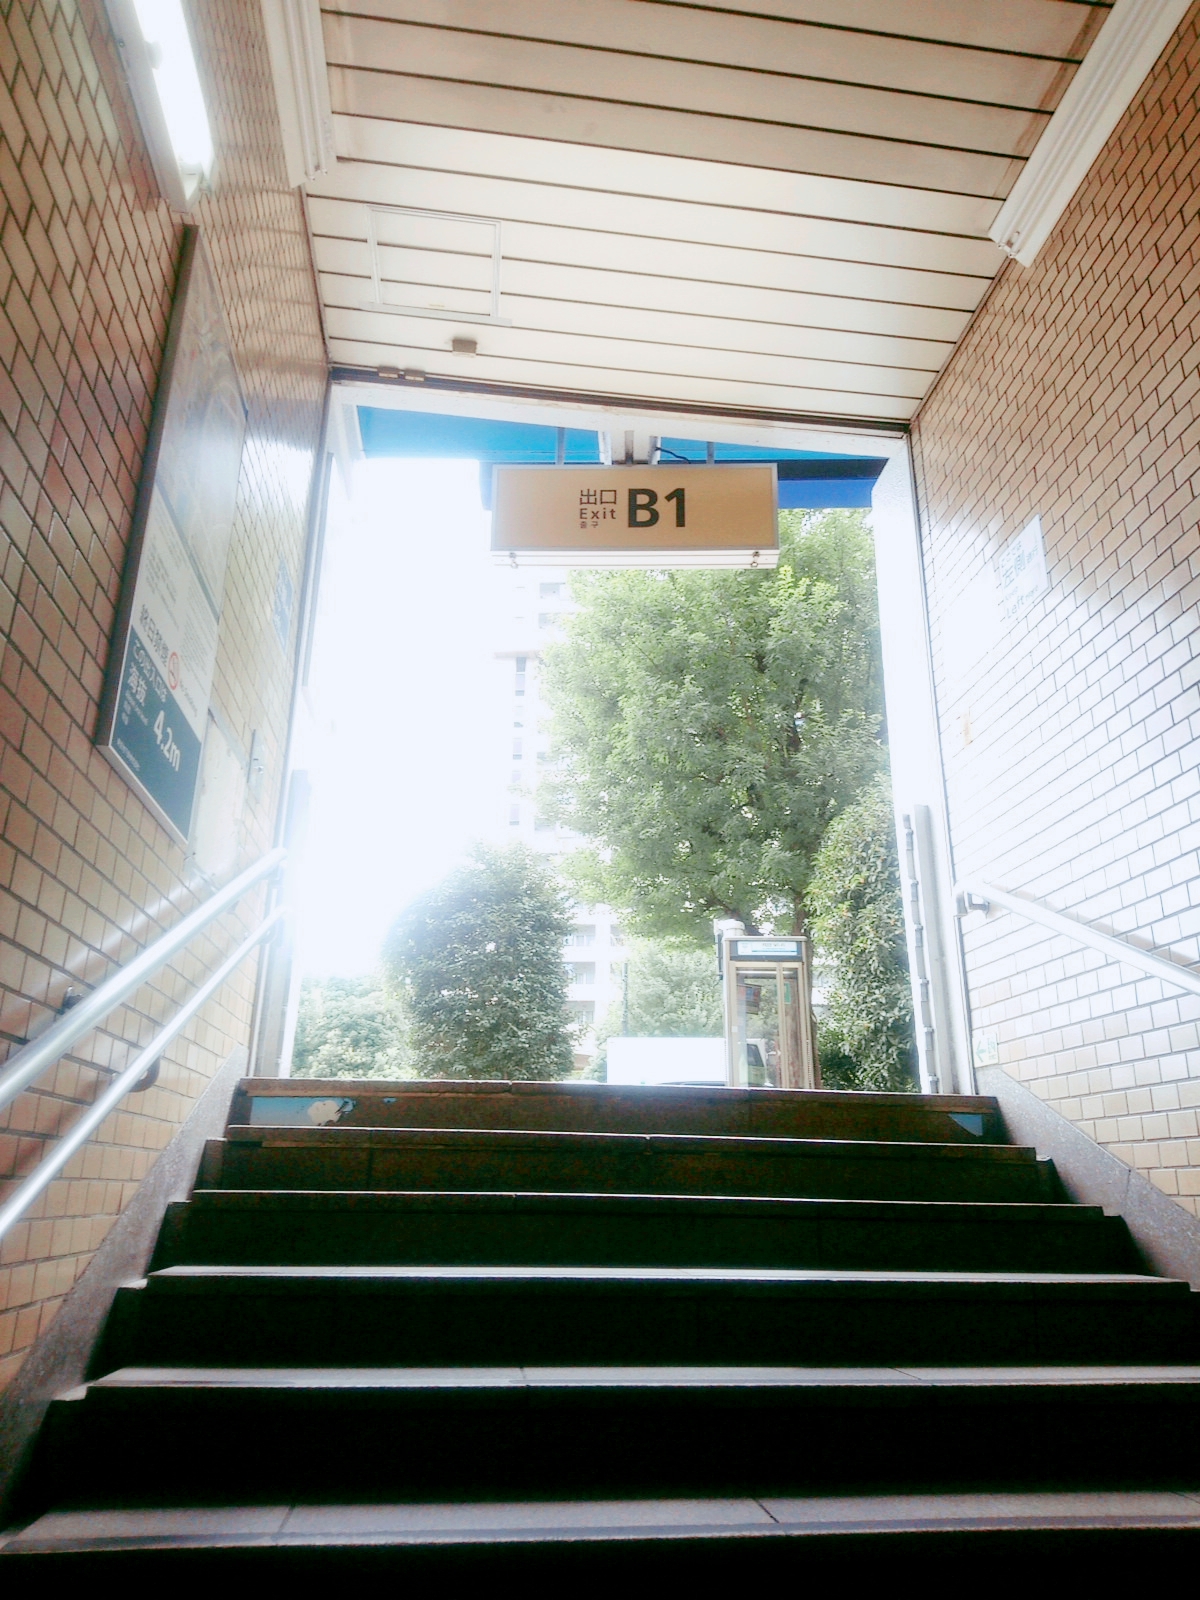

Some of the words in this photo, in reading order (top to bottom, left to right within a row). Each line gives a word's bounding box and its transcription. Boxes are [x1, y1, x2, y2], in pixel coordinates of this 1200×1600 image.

[579, 488, 617, 505] 出口
[628, 488, 685, 527] B1
[580, 508, 616, 519] Exit
[154, 710, 180, 771] 4.2m
